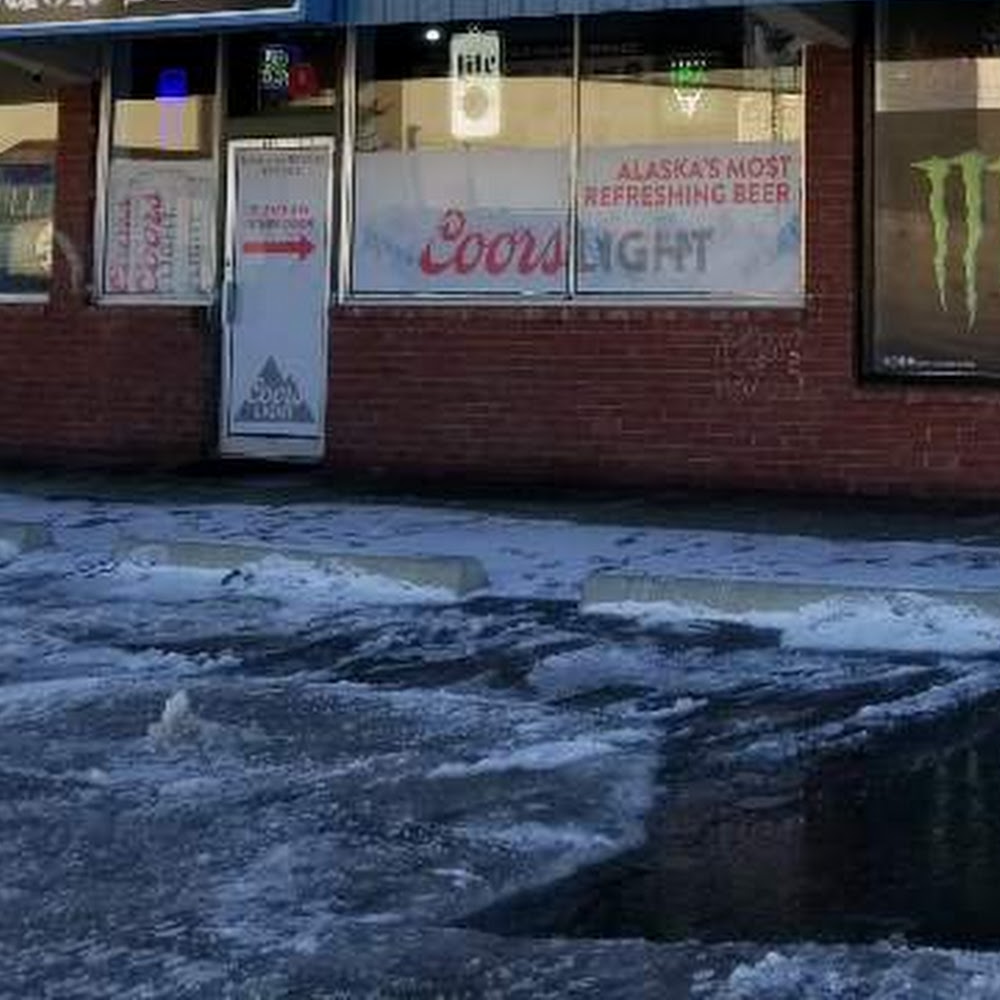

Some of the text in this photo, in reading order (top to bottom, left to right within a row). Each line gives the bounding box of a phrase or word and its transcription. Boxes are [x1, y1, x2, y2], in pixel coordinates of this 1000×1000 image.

[617, 154, 792, 181] ALASKA'S MOST
[584, 182, 791, 208] REFRESHING BEER
[420, 209, 566, 275] Coors
